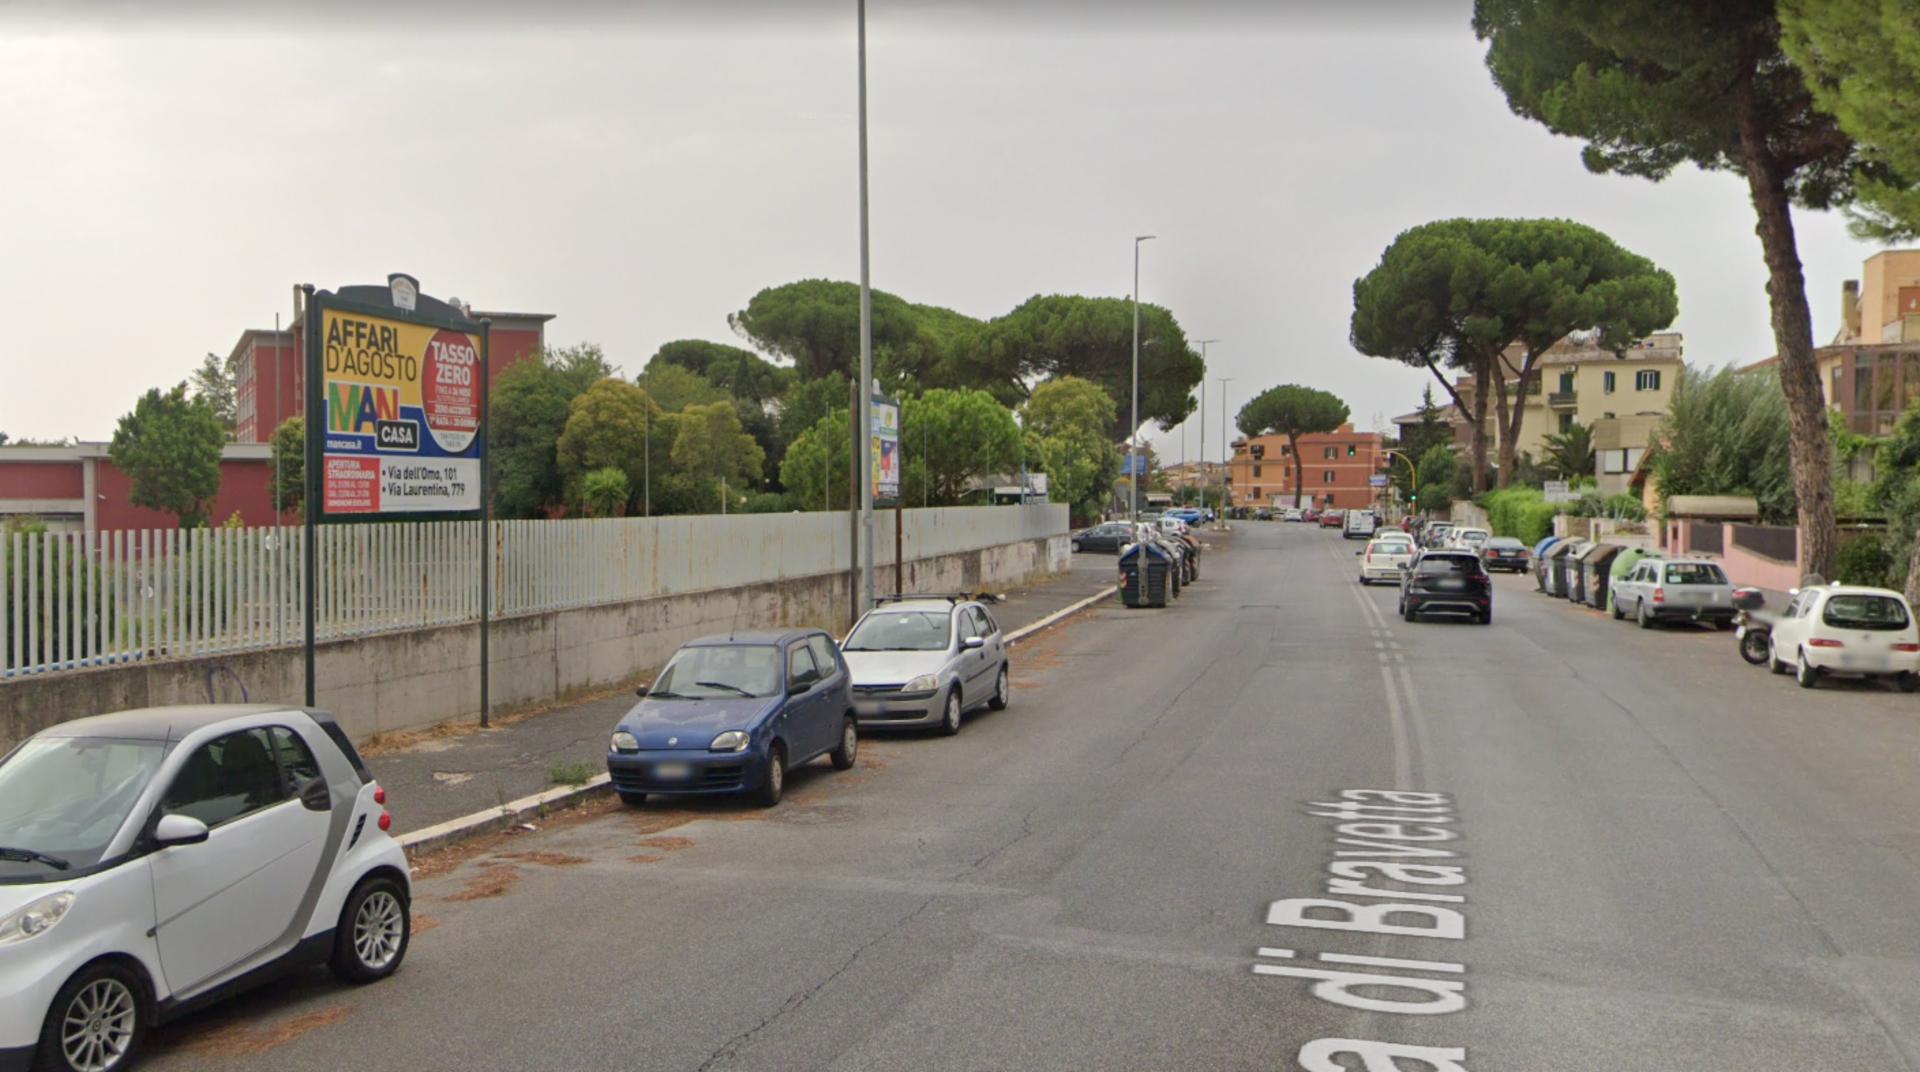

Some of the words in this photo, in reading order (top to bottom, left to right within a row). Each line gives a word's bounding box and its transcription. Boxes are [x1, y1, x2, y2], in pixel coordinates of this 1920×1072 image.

[327, 317, 398, 353] AFFARI
[326, 345, 417, 381] D'AGOSTO
[431, 341, 474, 366] TASSO
[436, 363, 471, 386] ZERO
[328, 383, 398, 432] MAN
[327, 440, 362, 450] mancasa.it
[381, 426, 413, 444] CASA
[388, 466, 401, 480] Via
[444, 467, 457, 480] 101
[388, 482, 401, 496] Via
[403, 483, 450, 497] Laurentina,
[451, 482, 465, 496] 779
[1266, 789, 1465, 939] Bravetta
[1253, 947, 1465, 1015] di
